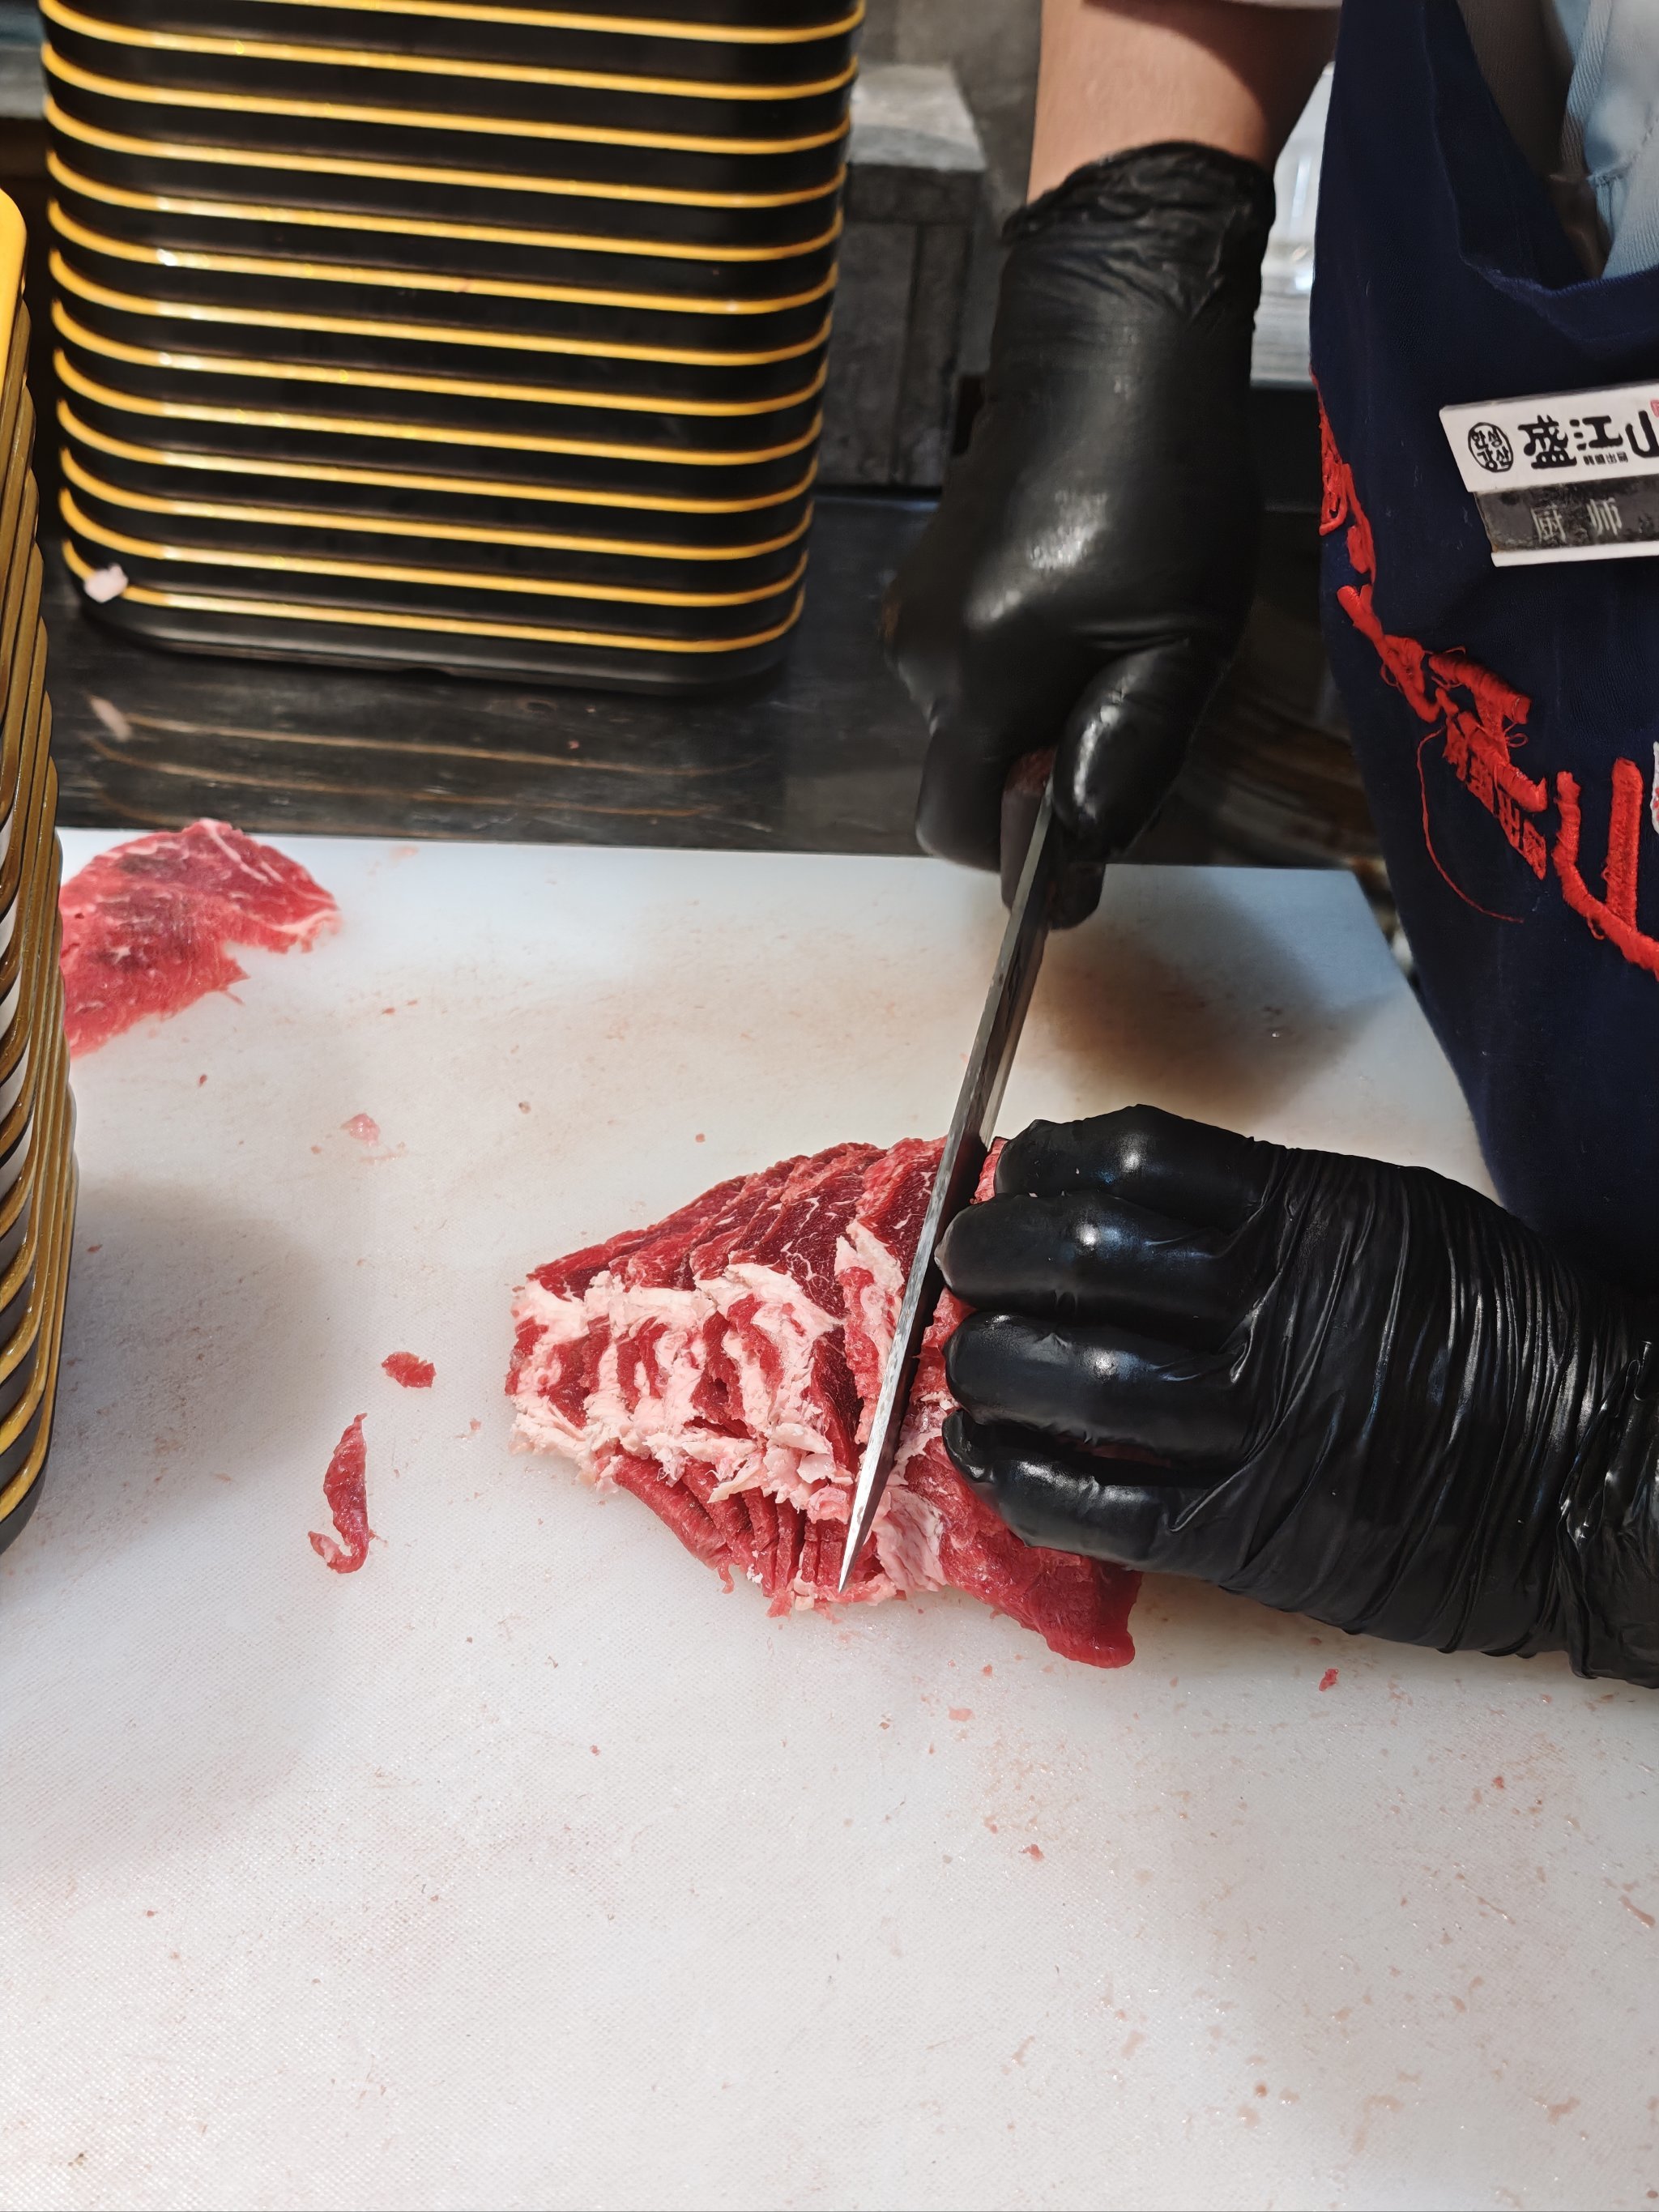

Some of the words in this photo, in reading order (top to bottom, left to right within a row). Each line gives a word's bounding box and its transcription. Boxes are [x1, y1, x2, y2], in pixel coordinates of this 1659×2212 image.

[1517, 411, 1659, 469] 盛江山
[1530, 497, 1623, 543] 厨师
